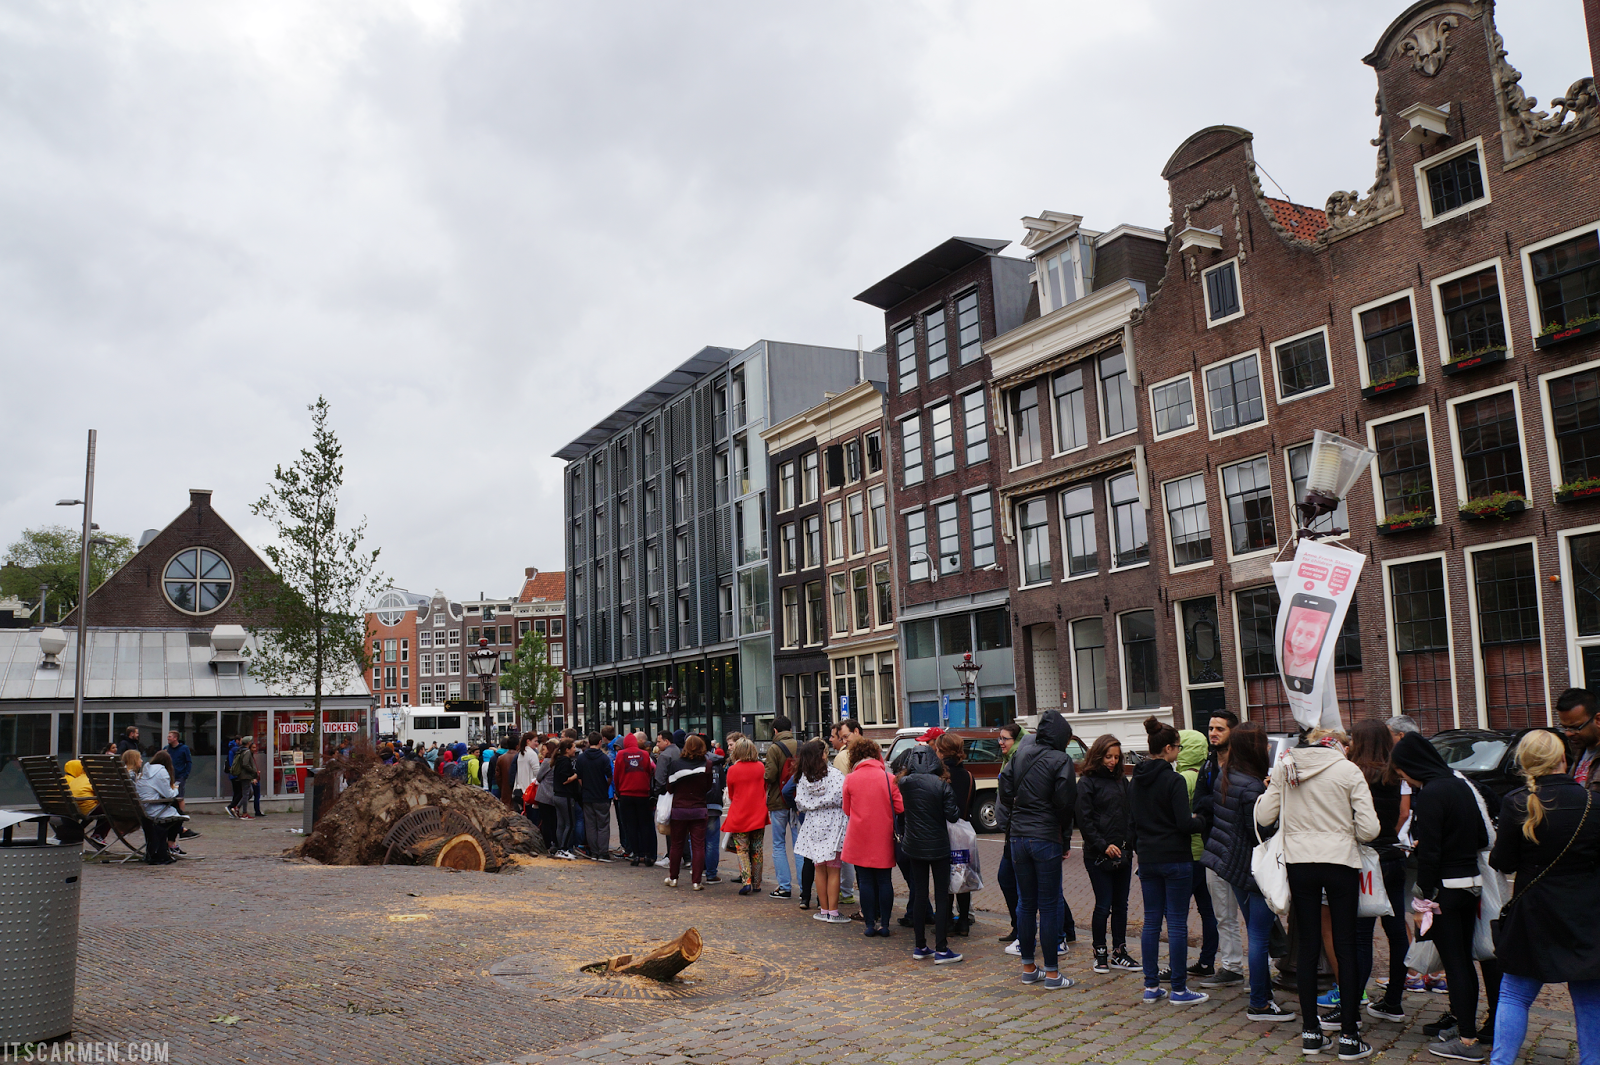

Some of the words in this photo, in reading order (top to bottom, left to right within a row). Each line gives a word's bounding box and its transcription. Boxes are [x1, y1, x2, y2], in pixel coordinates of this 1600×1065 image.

[1300, 565, 1327, 575] Download
[842, 698, 847, 708] P
[280, 724, 307, 733] TOURS
[323, 723, 357, 732] TICKETS
[1275, 852, 1285, 869] K
